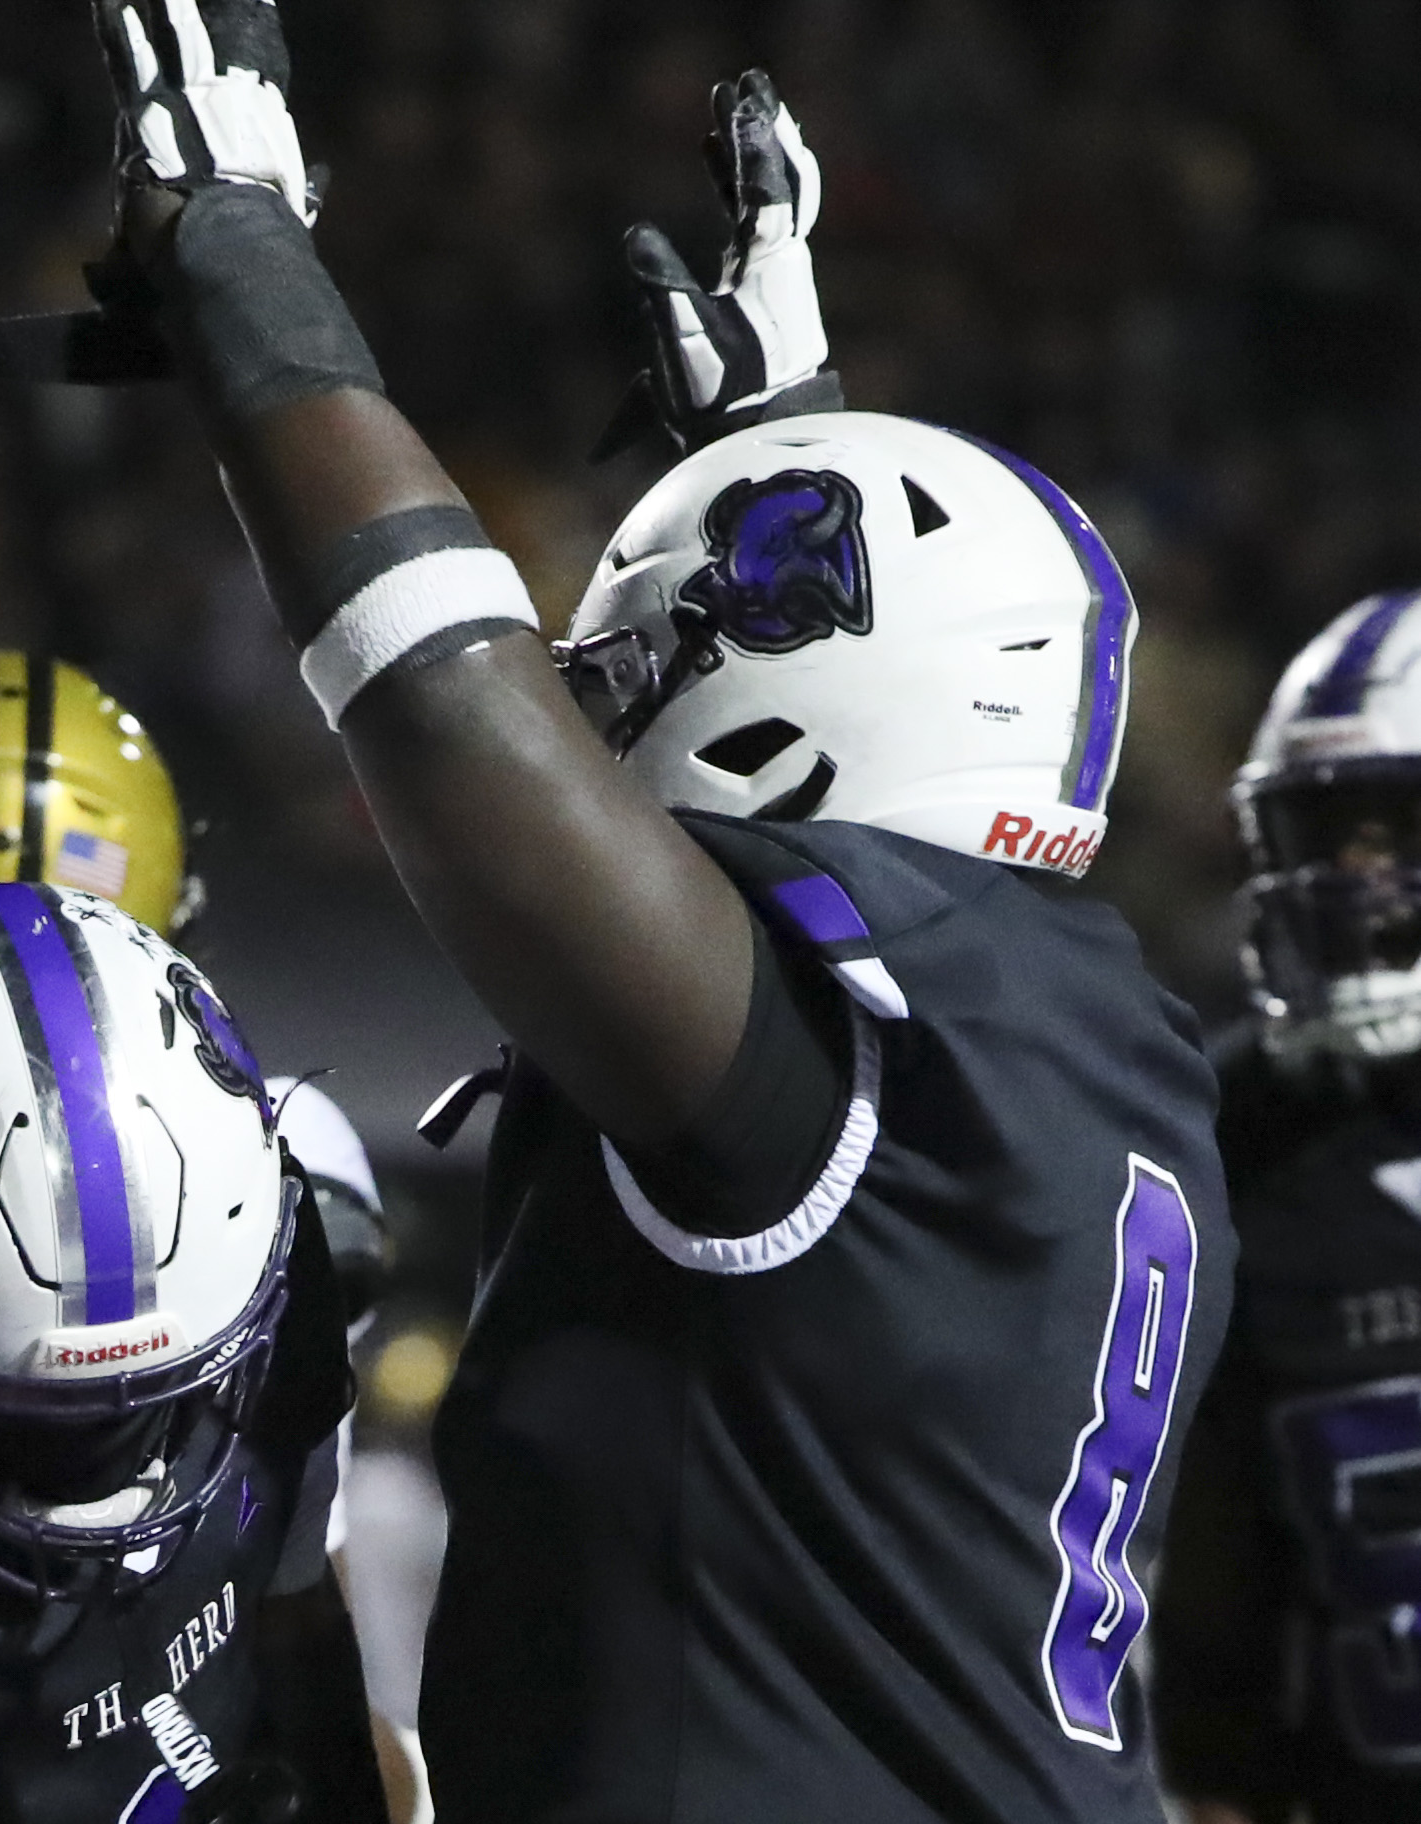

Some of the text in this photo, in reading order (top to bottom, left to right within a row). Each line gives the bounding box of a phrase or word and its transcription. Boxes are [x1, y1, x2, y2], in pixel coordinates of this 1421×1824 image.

[973, 700, 1021, 715] Riddell
[983, 810, 1099, 872] Ridde
[45, 1327, 170, 1369] Riddell
[63, 1581, 236, 1750] TH HERD
[141, 1692, 221, 1792] NXTRND
